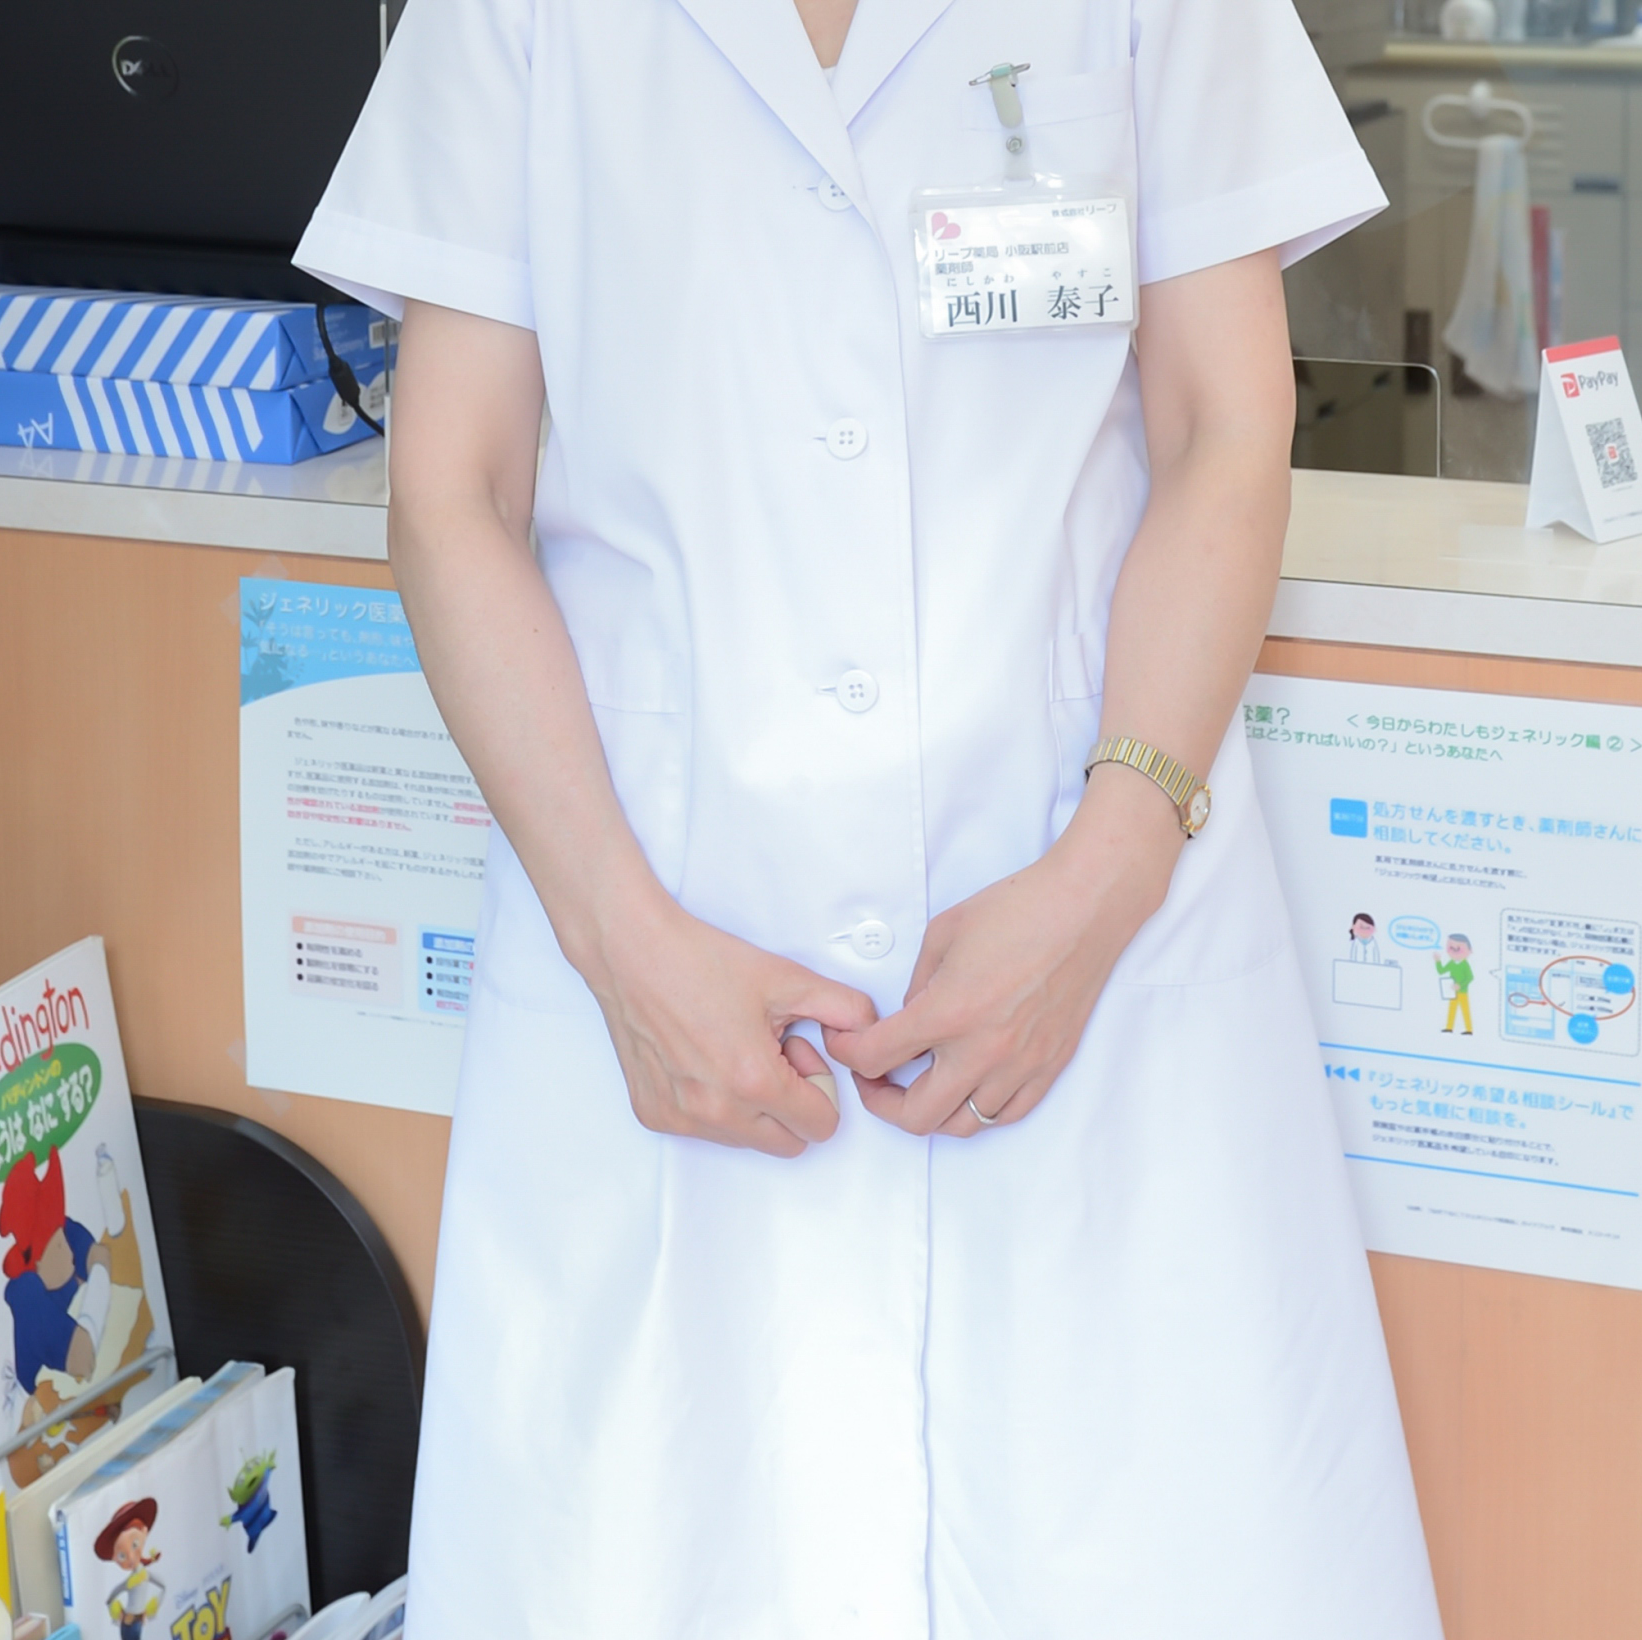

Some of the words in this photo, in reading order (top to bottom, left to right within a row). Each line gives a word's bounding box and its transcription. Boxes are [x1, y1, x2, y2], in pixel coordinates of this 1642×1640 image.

[934, 245, 999, 262] リーフ薬局
[934, 260, 975, 277] 薬剤師
[1051, 267, 1113, 282] やすこ
[943, 288, 1020, 329] 西川
[1046, 282, 1121, 321] 泰子
[1578, 369, 1620, 397] PayPay
[1365, 714, 1602, 751] 今日からわたしもジェネリック編
[1373, 824, 1513, 856] 相談してください。
[26, 1091, 59, 1143] なに
[1369, 1094, 1527, 1130] もっと気軽に相談を。
[170, 1574, 233, 1640] TOY
